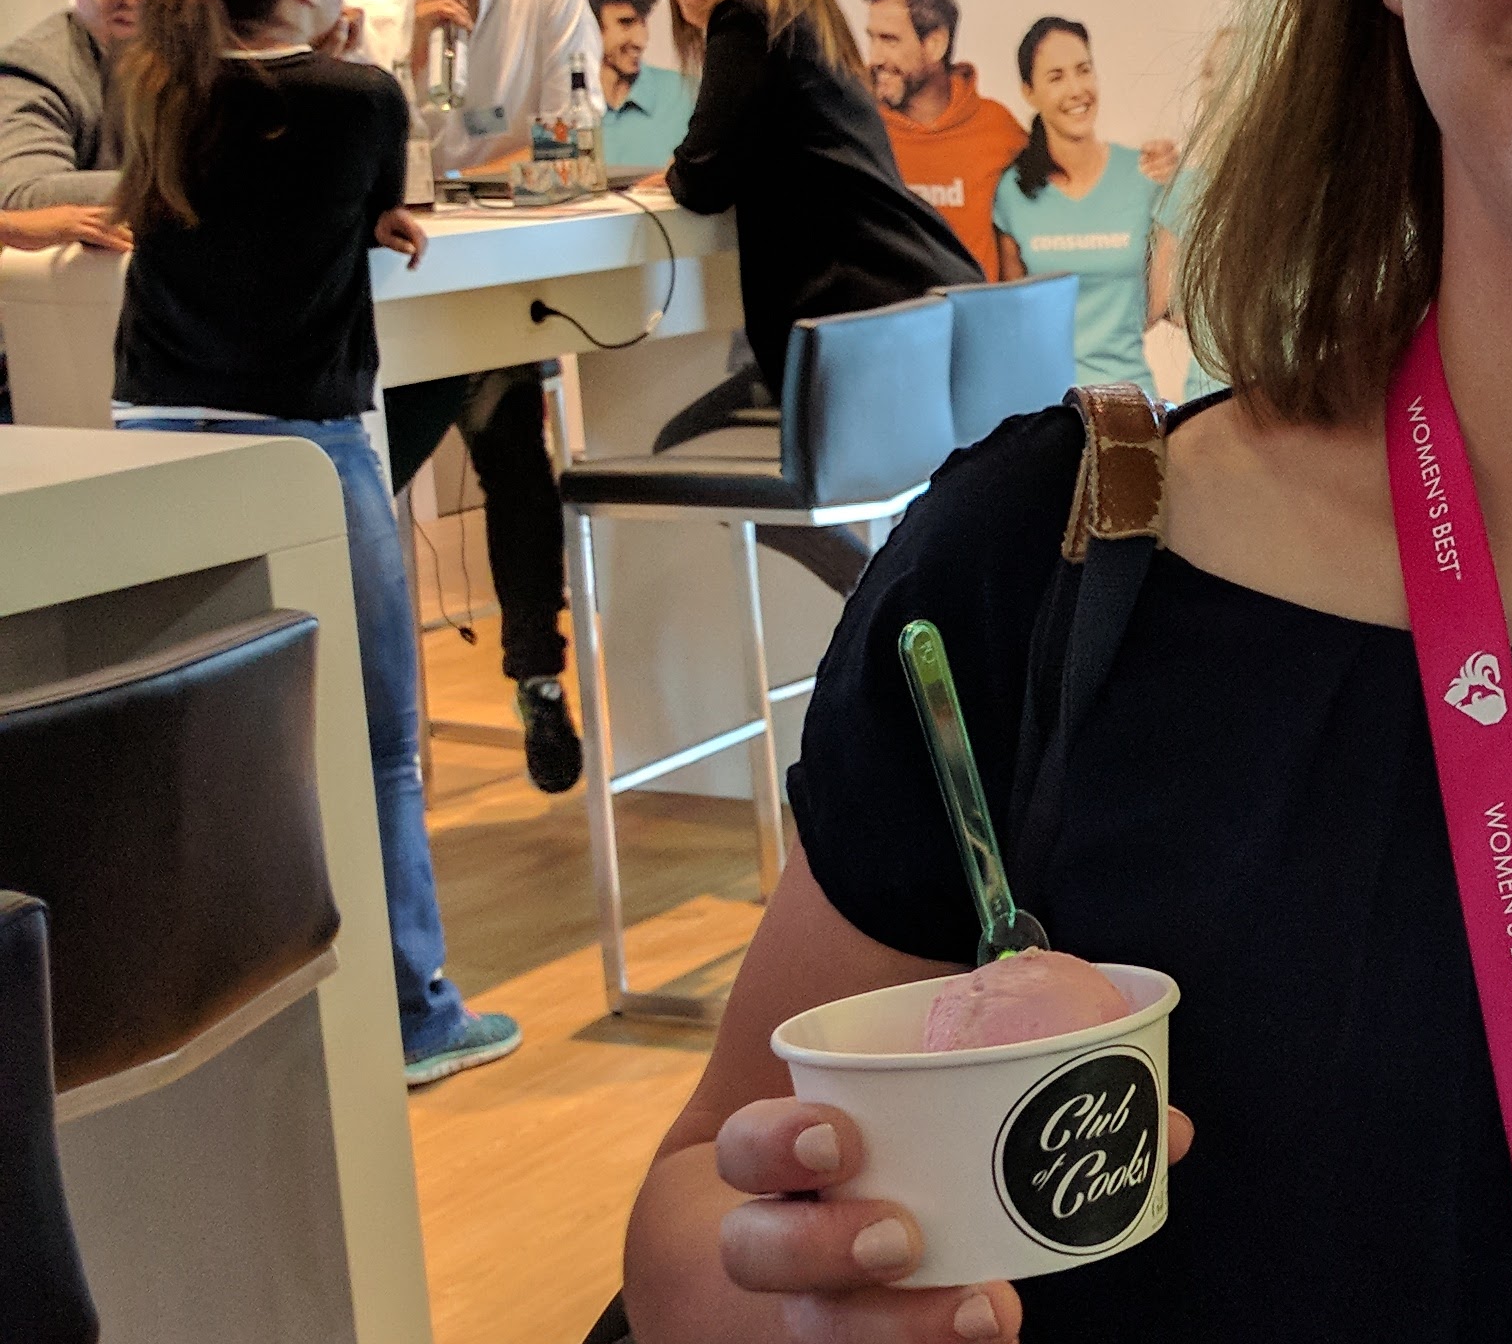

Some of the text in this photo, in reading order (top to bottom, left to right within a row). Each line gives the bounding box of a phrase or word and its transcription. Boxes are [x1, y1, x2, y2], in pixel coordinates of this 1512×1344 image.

[1407, 395, 1449, 519] WOMEN'S
[1040, 1083, 1136, 1152] Club
[1031, 1152, 1067, 1191] of
[1052, 1129, 1150, 1219] Cooks
